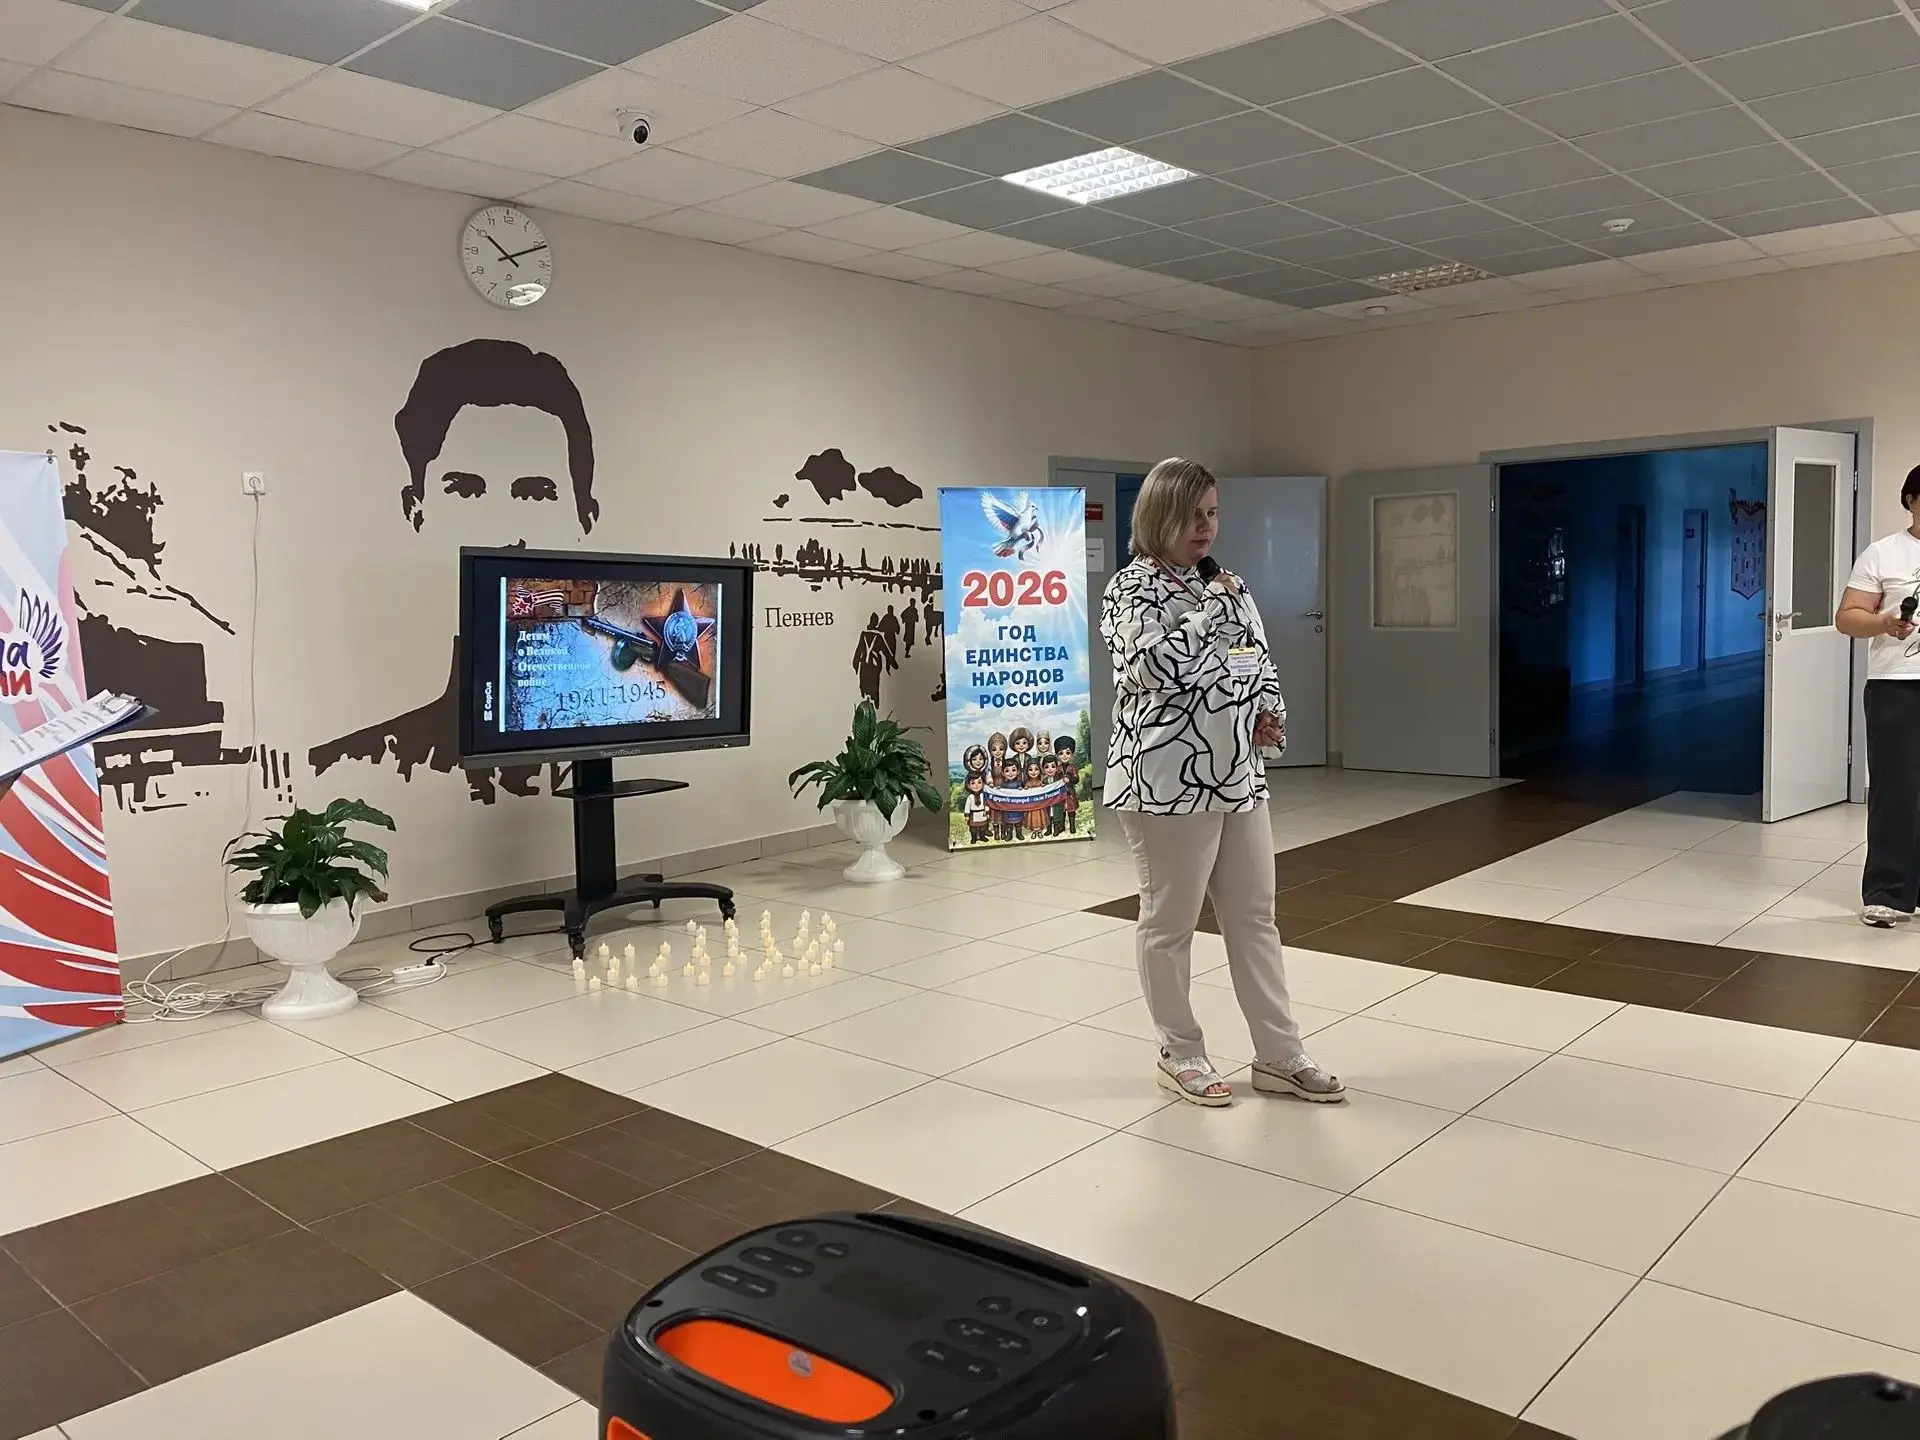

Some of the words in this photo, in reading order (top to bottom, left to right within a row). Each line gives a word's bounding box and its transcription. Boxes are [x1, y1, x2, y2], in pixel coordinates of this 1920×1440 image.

[963, 570, 1068, 607] 2026
[764, 607, 834, 627] Певнев
[517, 630, 550, 643] Детям
[998, 624, 1036, 642] ГОД
[965, 646, 1069, 666] ЕДИНСТВА
[972, 668, 1064, 687] НАРОДОВ
[484, 681, 493, 710] CapCut
[556, 680, 666, 712] 1941-1945
[979, 690, 1058, 709] РОССИИ
